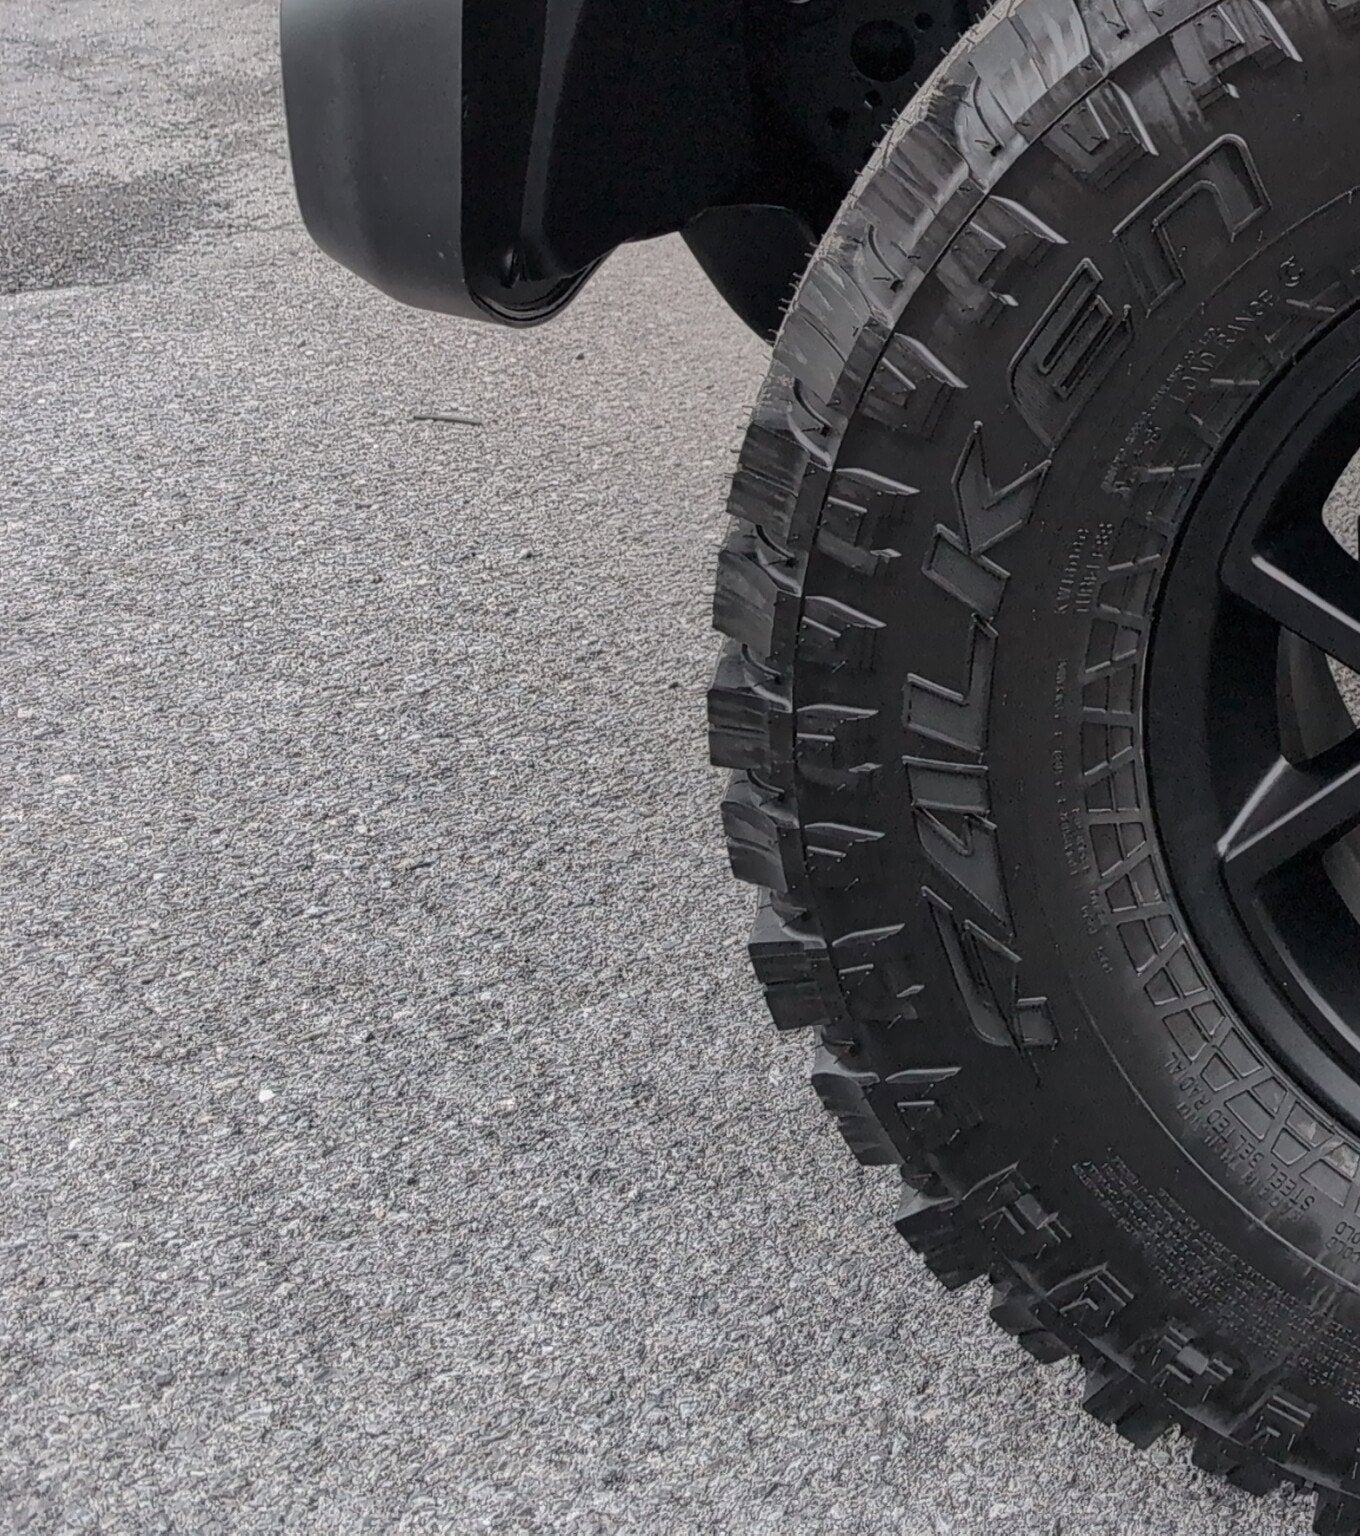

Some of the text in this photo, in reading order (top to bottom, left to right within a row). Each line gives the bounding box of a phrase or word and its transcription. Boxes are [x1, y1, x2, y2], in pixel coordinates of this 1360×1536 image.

[1158, 1050, 1317, 1214] STEEL BELTED RADIAL
